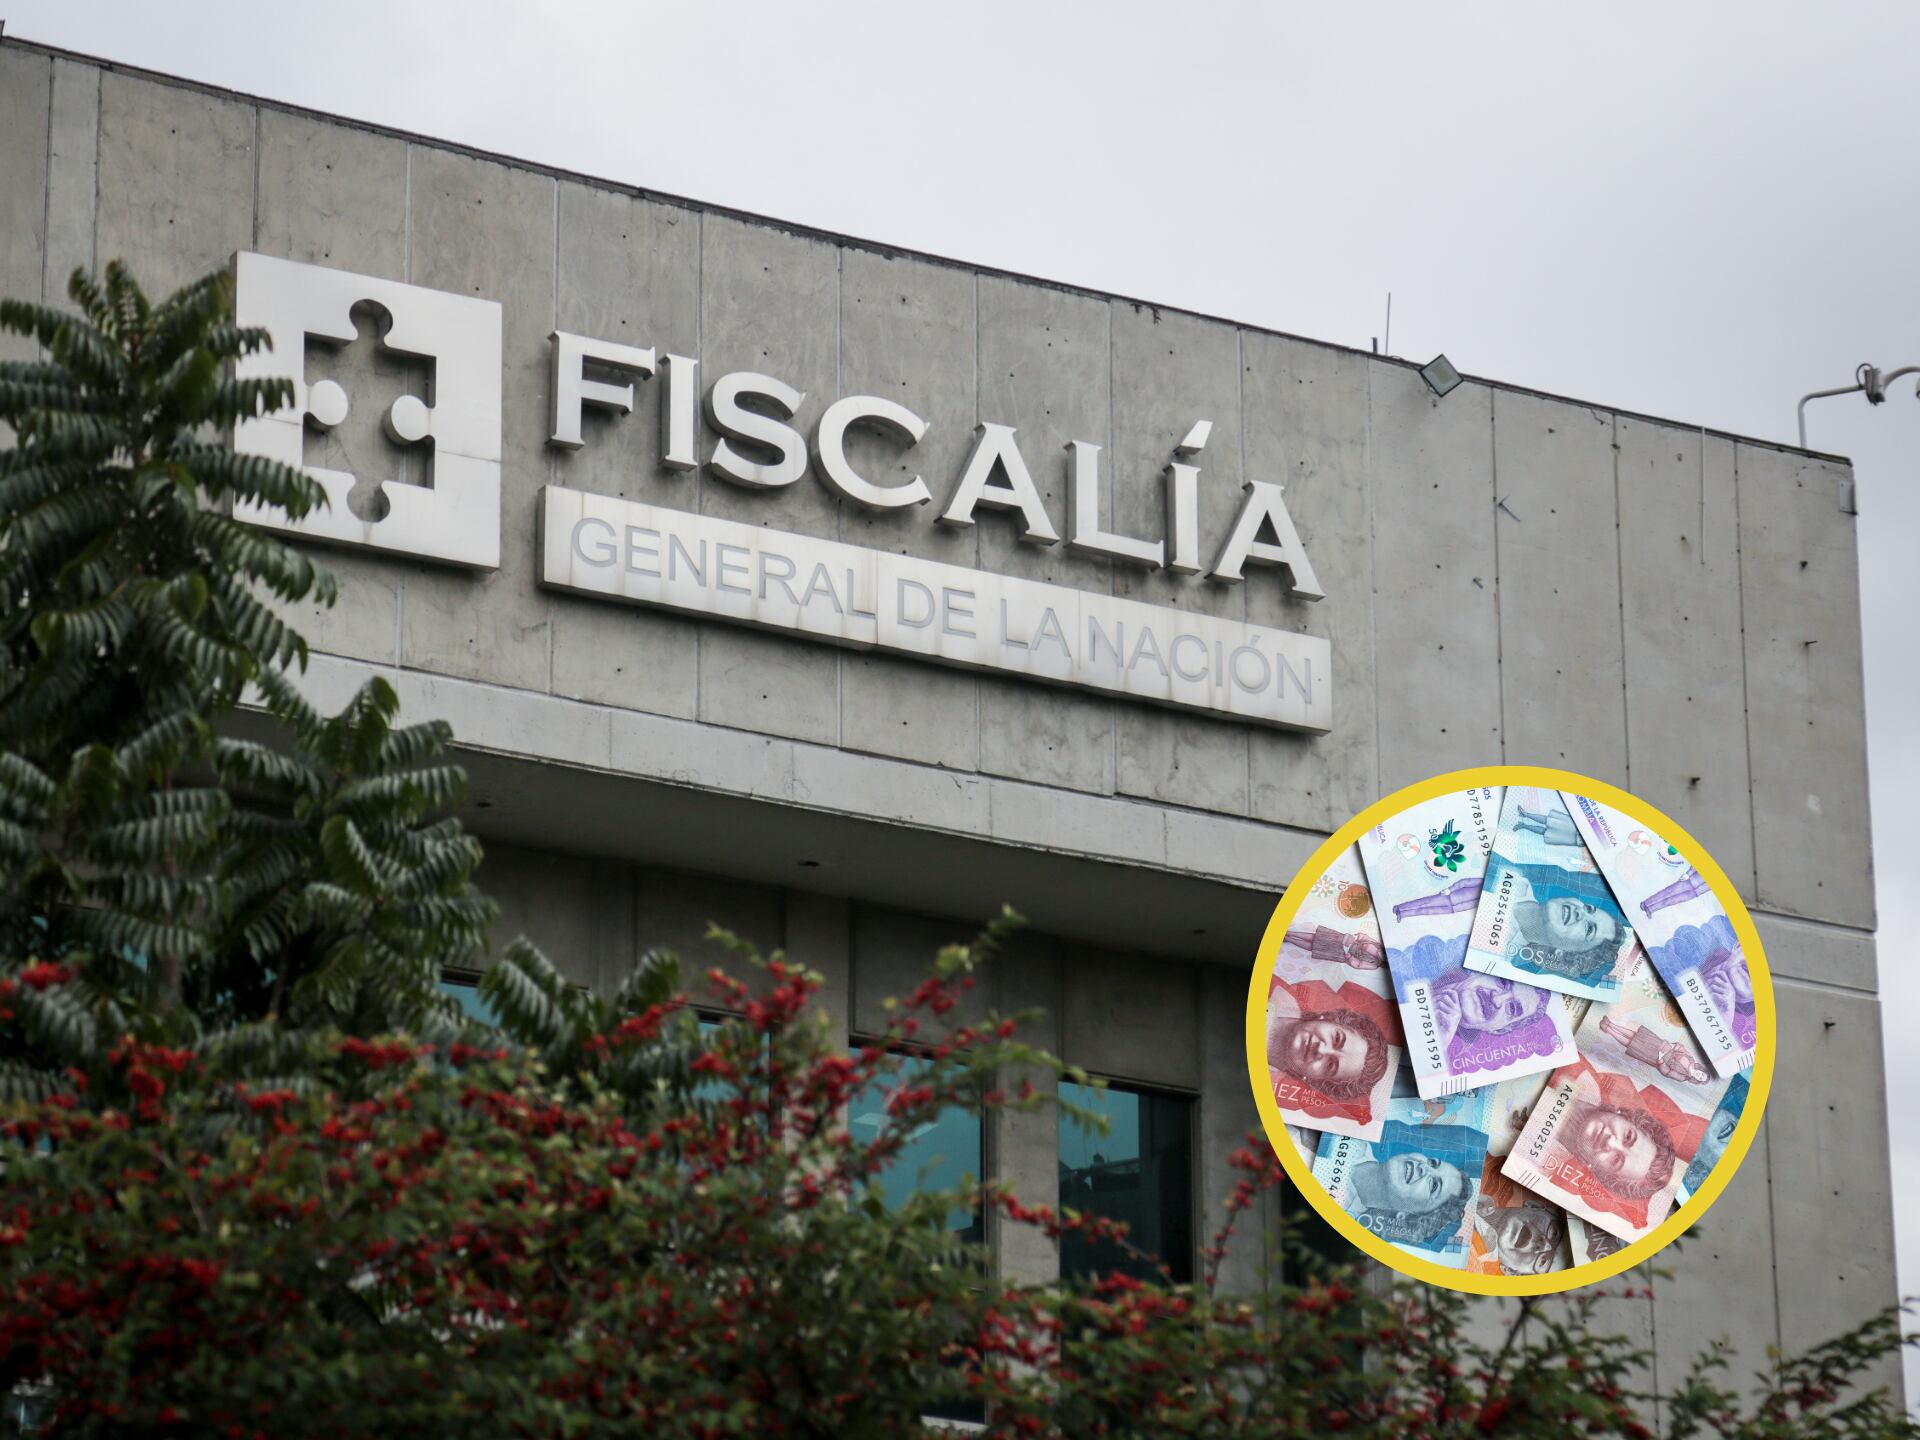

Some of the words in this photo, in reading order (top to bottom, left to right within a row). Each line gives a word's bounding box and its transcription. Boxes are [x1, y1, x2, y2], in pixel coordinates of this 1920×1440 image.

[546, 329, 1325, 601] FISCALÍA
[570, 516, 877, 621] GENERAL
[896, 577, 978, 640] DE
[1000, 597, 1072, 659] LA
[1087, 614, 1313, 705] NACIÓN
[1489, 871, 1514, 947] AG82545065
[1506, 943, 1545, 964] DOS
[1415, 988, 1442, 1069] BD77851595
[1686, 978, 1732, 1050] BD37967155
[1452, 1044, 1525, 1070] CINCUENTA
[1529, 1084, 1573, 1158] AC83660255
[1544, 1155, 1584, 1187] DIEZ
